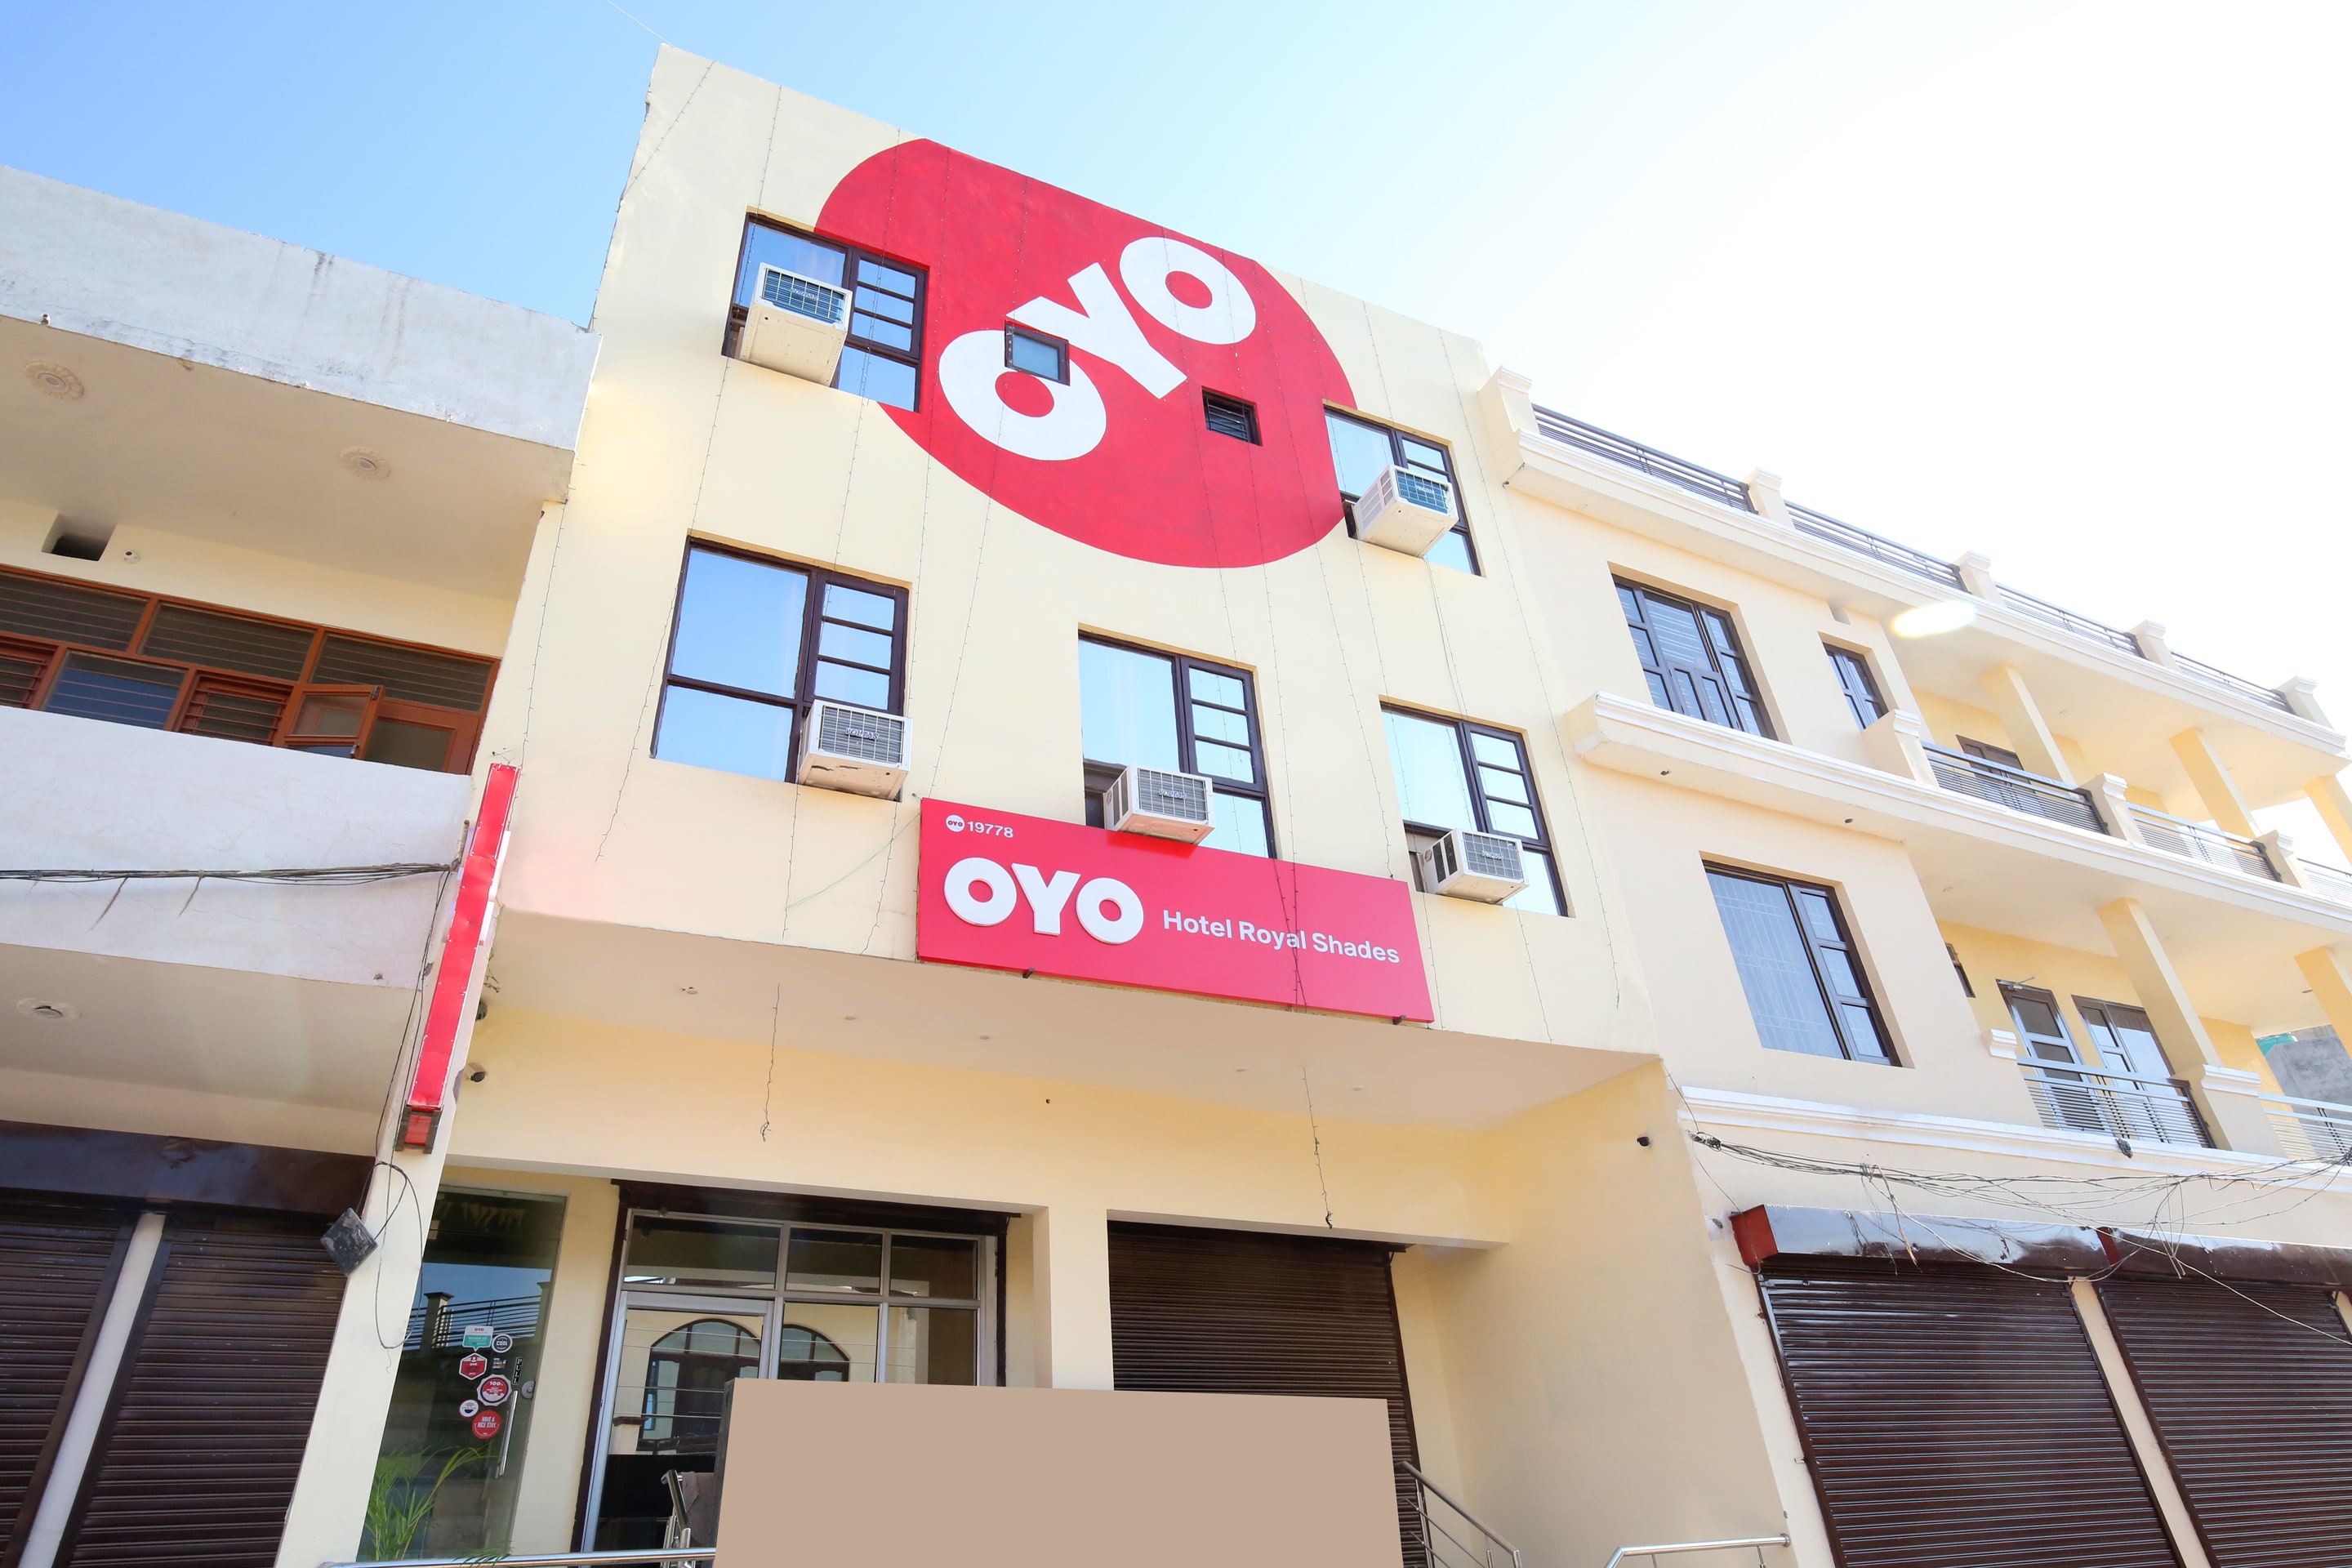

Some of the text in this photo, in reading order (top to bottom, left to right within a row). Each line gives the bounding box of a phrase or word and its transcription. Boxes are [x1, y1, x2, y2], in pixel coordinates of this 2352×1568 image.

[938, 237, 1257, 461] OYO
[844, 728, 880, 740] VOLTAS
[968, 821, 1013, 838] 19778
[944, 857, 1144, 945] OYO
[1163, 910, 1401, 963] Hotel Royal Shades
[514, 1357, 523, 1384] PULL
